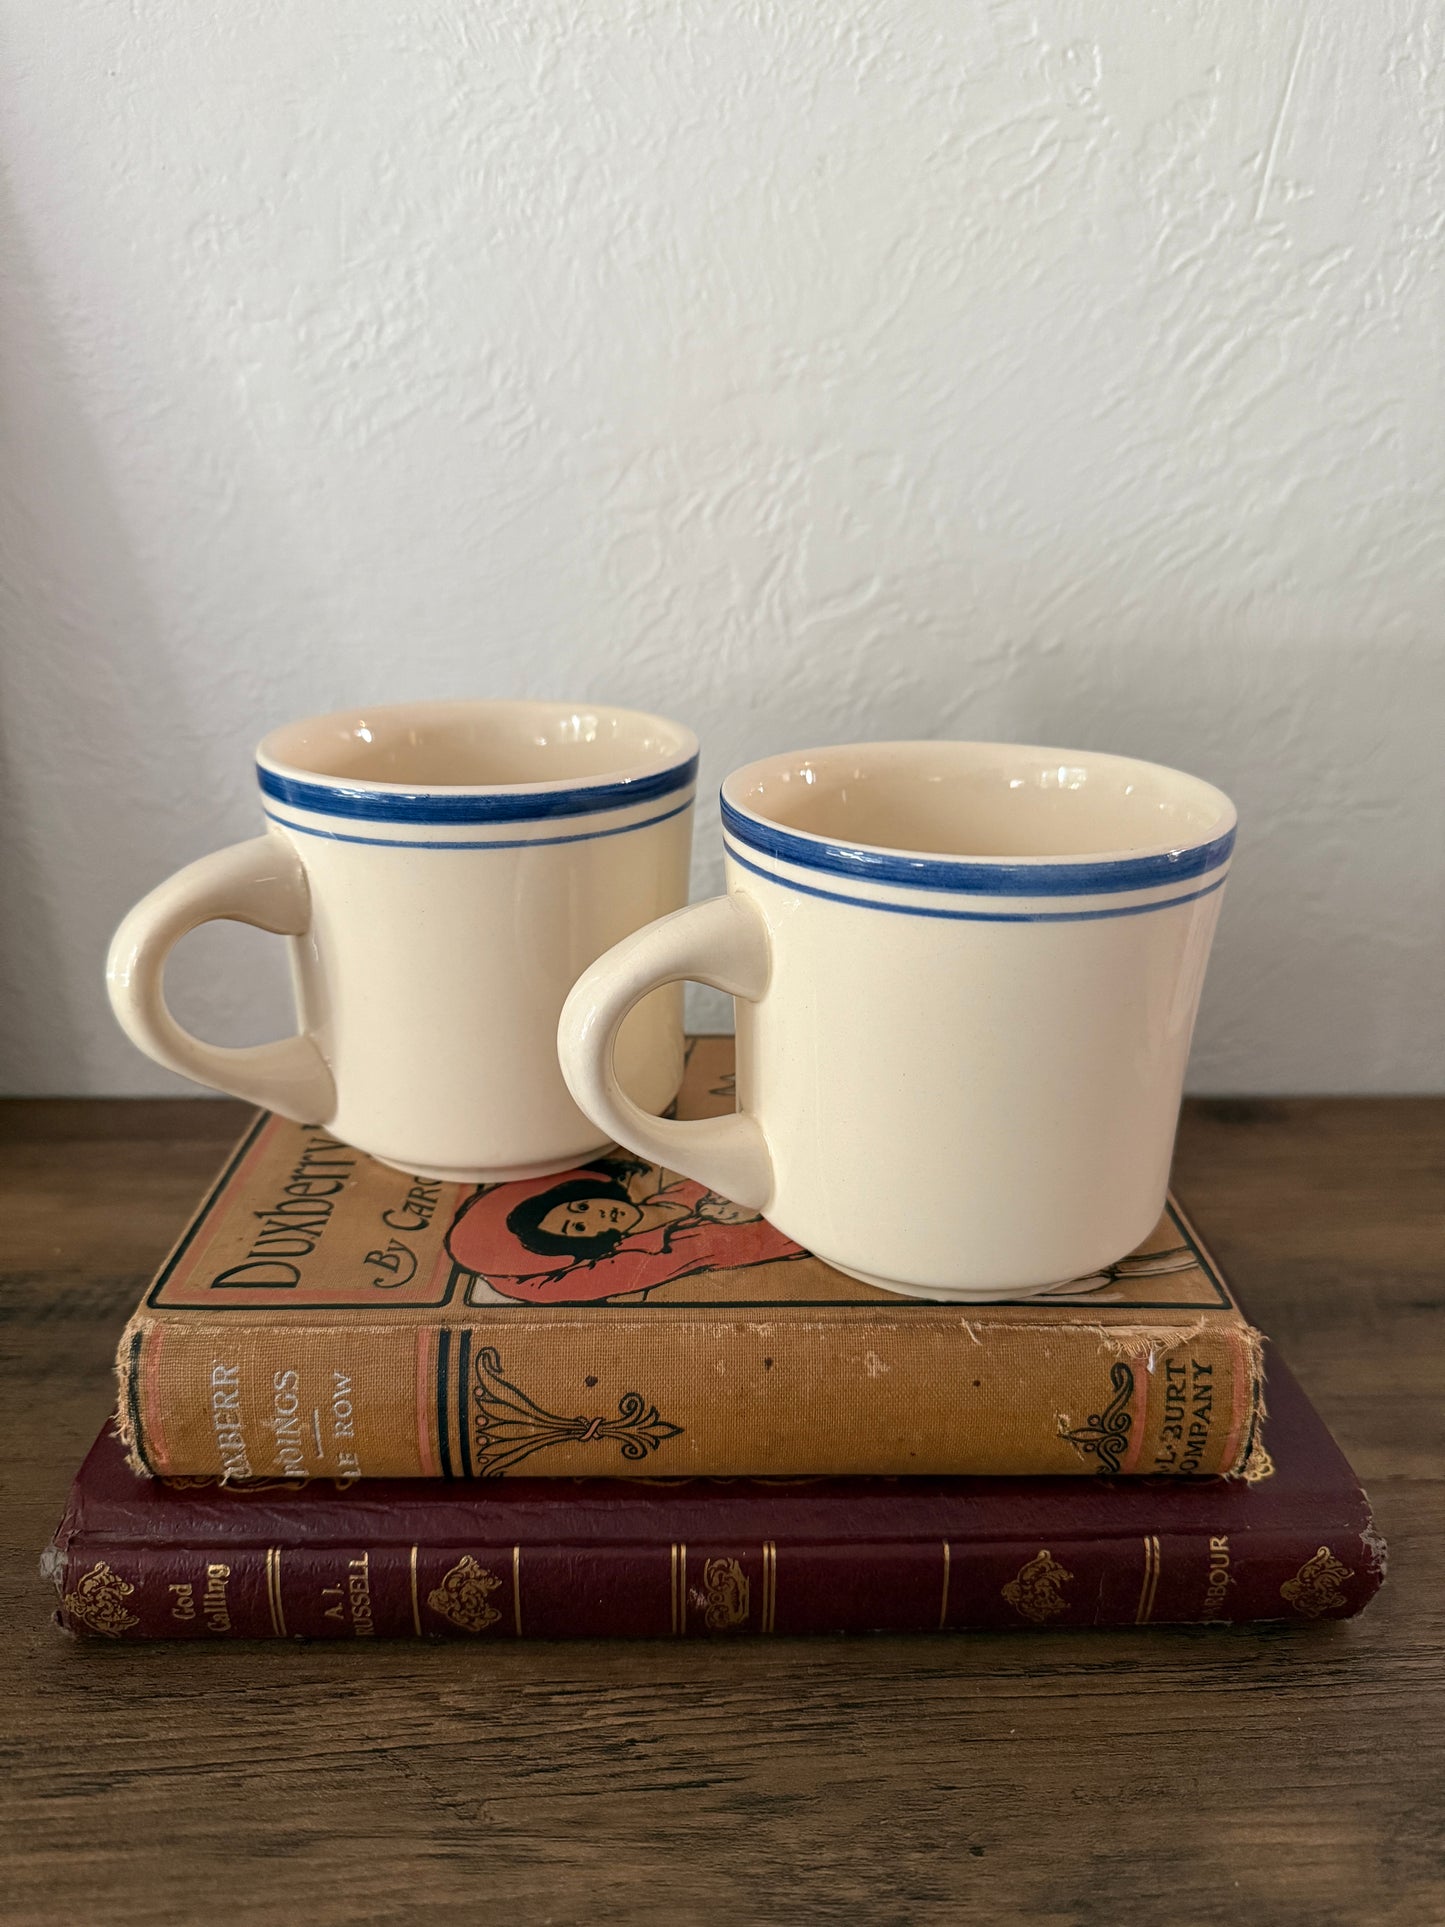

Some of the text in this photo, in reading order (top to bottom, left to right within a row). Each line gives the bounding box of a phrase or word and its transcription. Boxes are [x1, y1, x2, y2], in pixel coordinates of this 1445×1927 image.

[211, 1137, 356, 1289] Duxberry
[364, 1238, 418, 1289] By
[333, 1371, 356, 1438] ROW
[1180, 1358, 1213, 1474] OMPANY
[169, 1583, 195, 1620] God
[203, 1564, 231, 1632] Calling
[349, 1550, 375, 1636] RUSSELL
